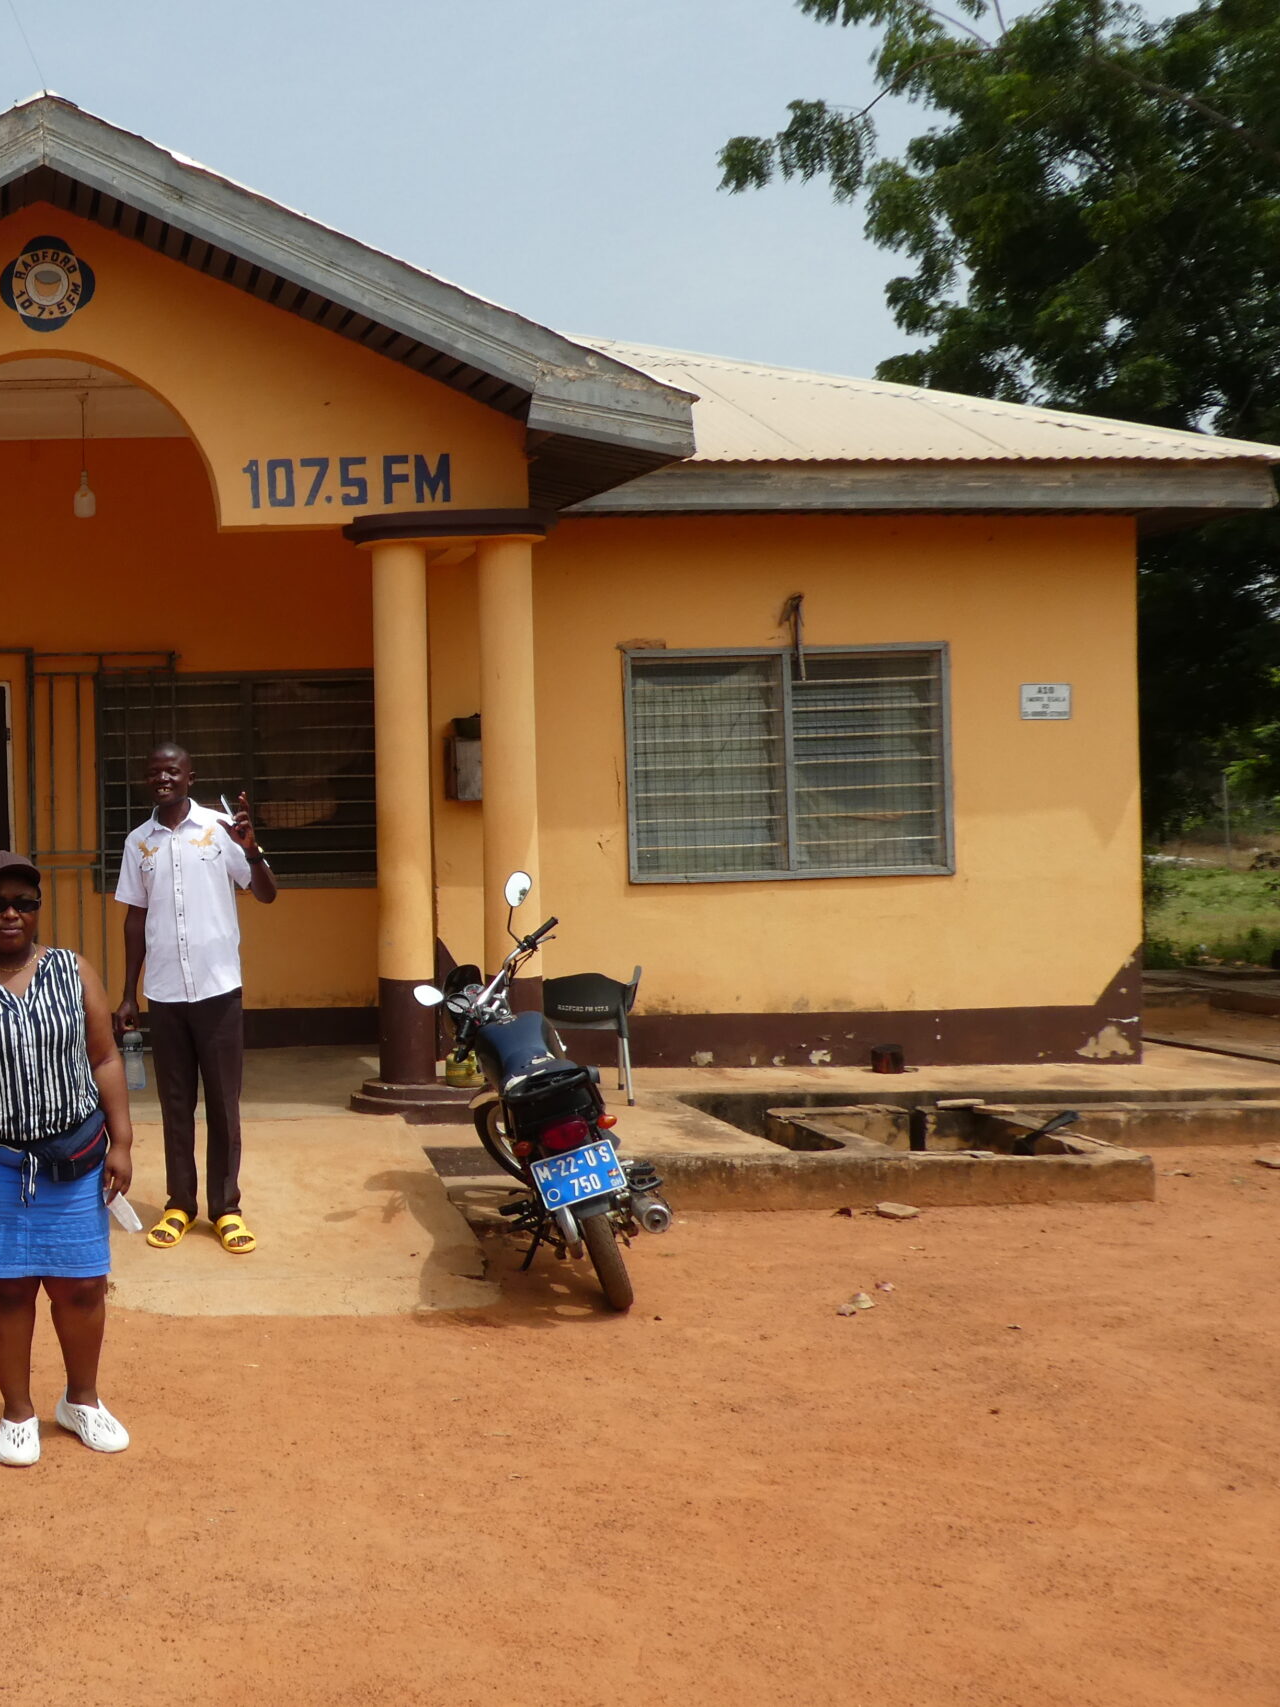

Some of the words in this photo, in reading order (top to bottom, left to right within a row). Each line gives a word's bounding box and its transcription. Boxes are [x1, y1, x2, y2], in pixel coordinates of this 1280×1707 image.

[14, 251, 78, 280] RADFORD
[242, 456, 369, 509] 107.5
[383, 453, 452, 505] FM
[569, 1173, 602, 1197] 750
